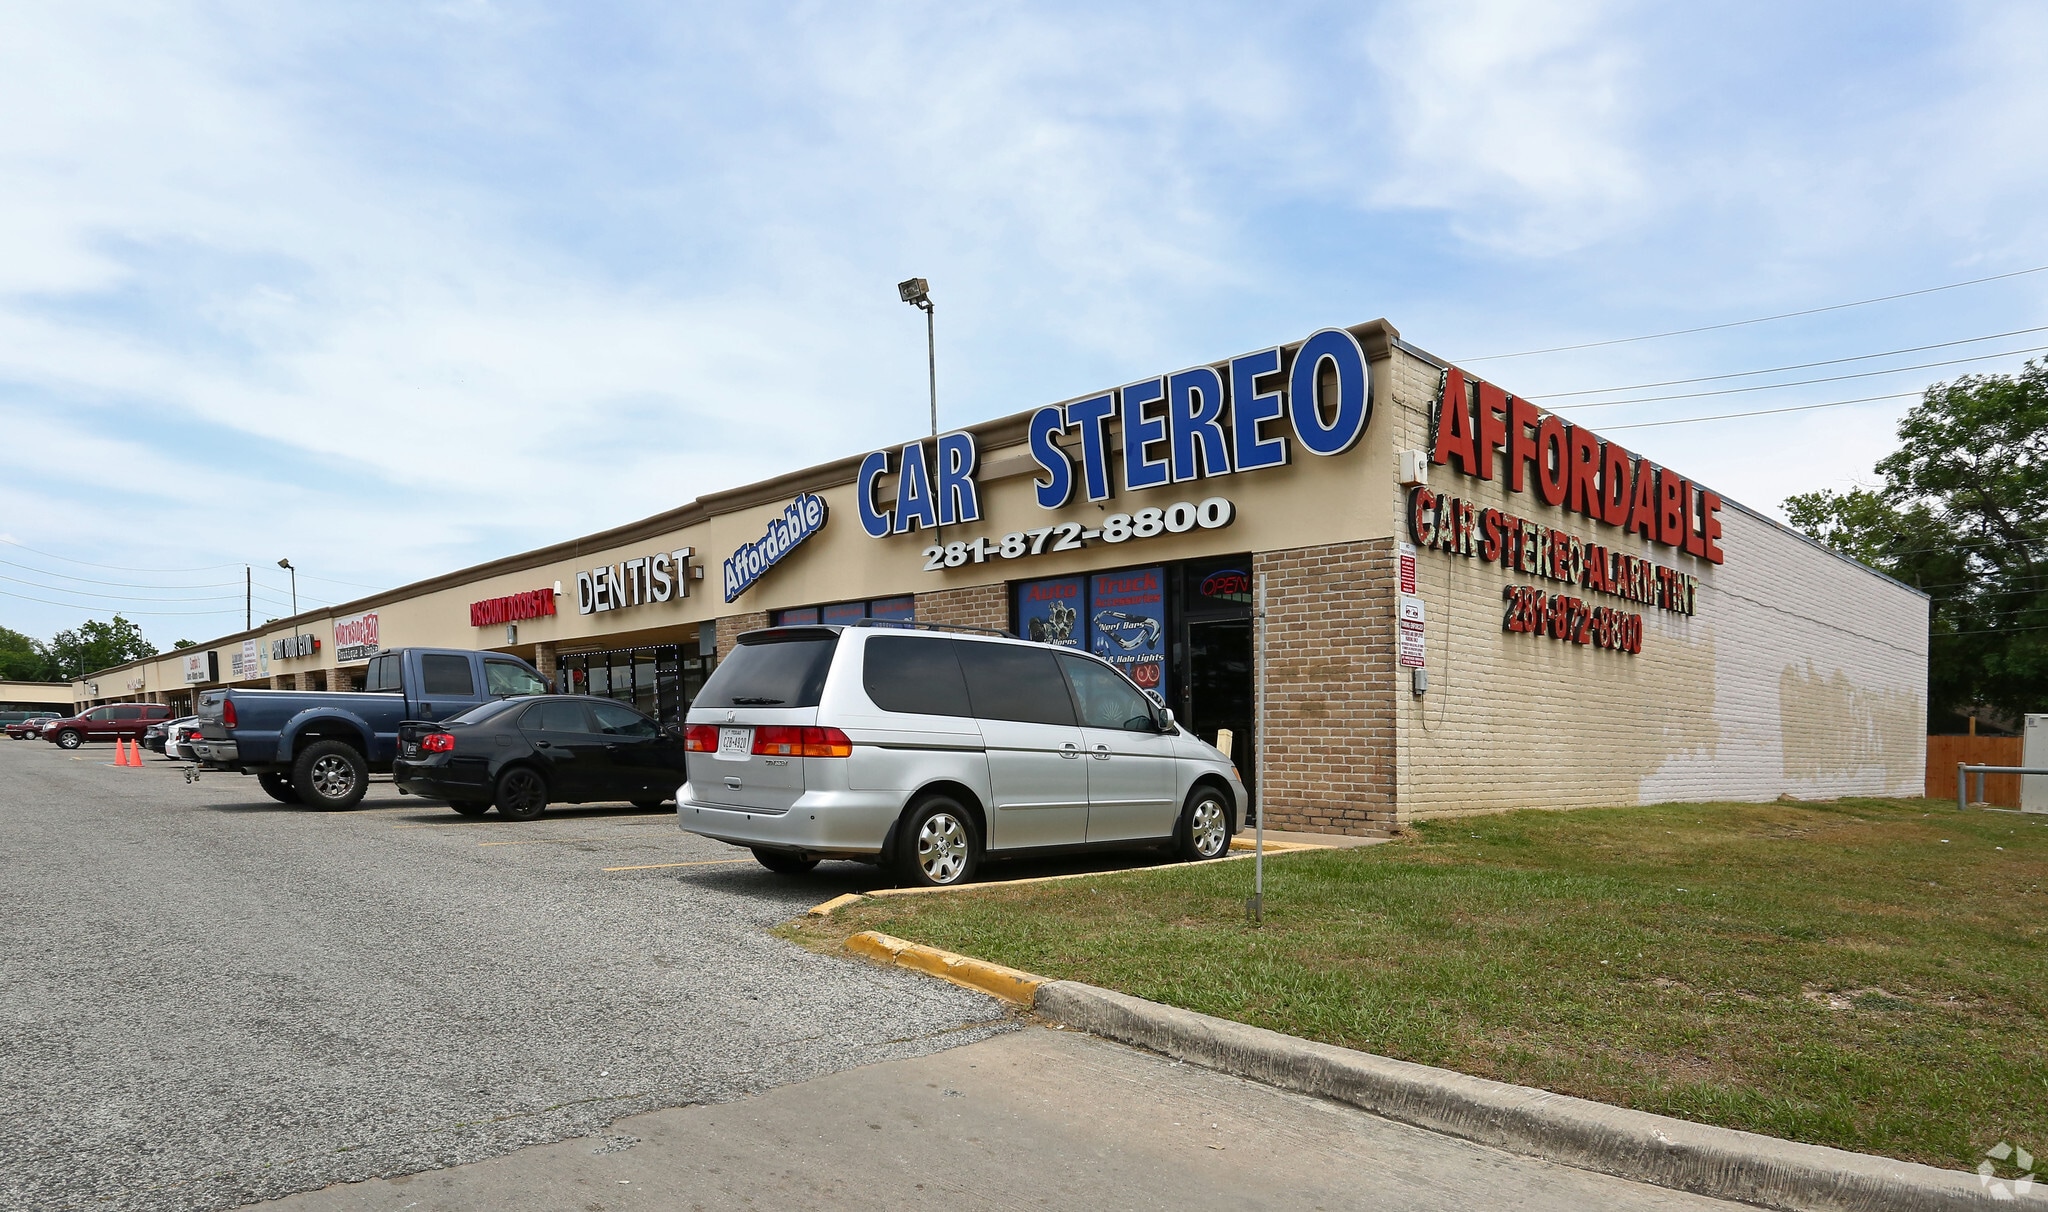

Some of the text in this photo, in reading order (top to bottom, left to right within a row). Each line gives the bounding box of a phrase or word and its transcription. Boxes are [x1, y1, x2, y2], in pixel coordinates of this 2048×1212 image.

[857, 327, 1369, 539] CAR STEREO
[1430, 367, 1724, 565] AFFORDABLE
[922, 496, 1232, 572] 281-872-8800
[1408, 485, 1478, 558] CAR
[723, 492, 829, 603] Affordable
[576, 547, 694, 616] DENTIST
[1027, 583, 1077, 602] Auto
[1094, 592, 1161, 608] Accessories
[1096, 572, 1157, 595] Truck
[1202, 576, 1250, 596] OPEN
[470, 596, 507, 627] DISCOUNT
[508, 590, 537, 620] DOORS
[1123, 621, 1145, 630] Bars
[1502, 584, 1643, 655] 281-872-8800
[1052, 638, 1078, 646] Horns
[1117, 655, 1134, 663] Halo
[1137, 653, 1164, 663] Lights
